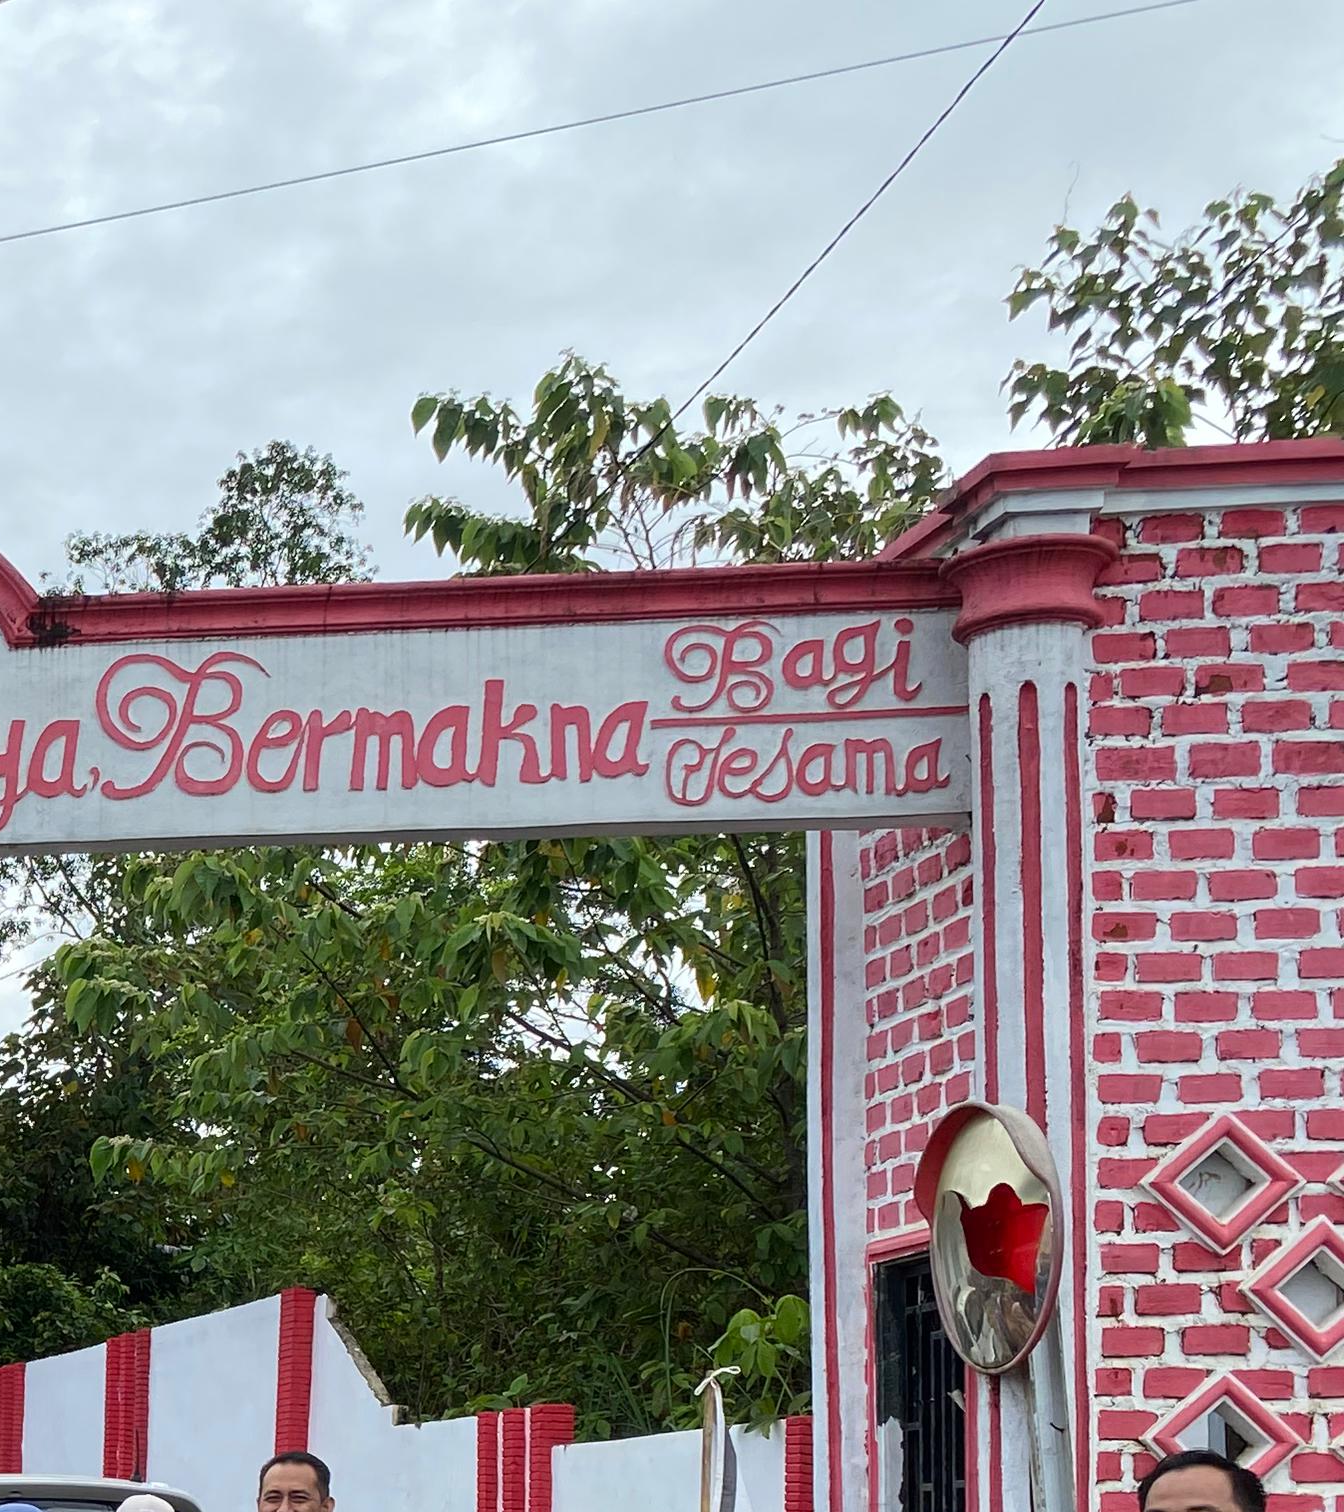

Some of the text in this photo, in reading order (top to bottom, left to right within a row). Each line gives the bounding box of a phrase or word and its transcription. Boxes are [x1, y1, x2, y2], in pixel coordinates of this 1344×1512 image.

[664, 617, 922, 713] Bagi
[93, 652, 651, 798] Bermakna
[665, 726, 951, 807] Sesama
